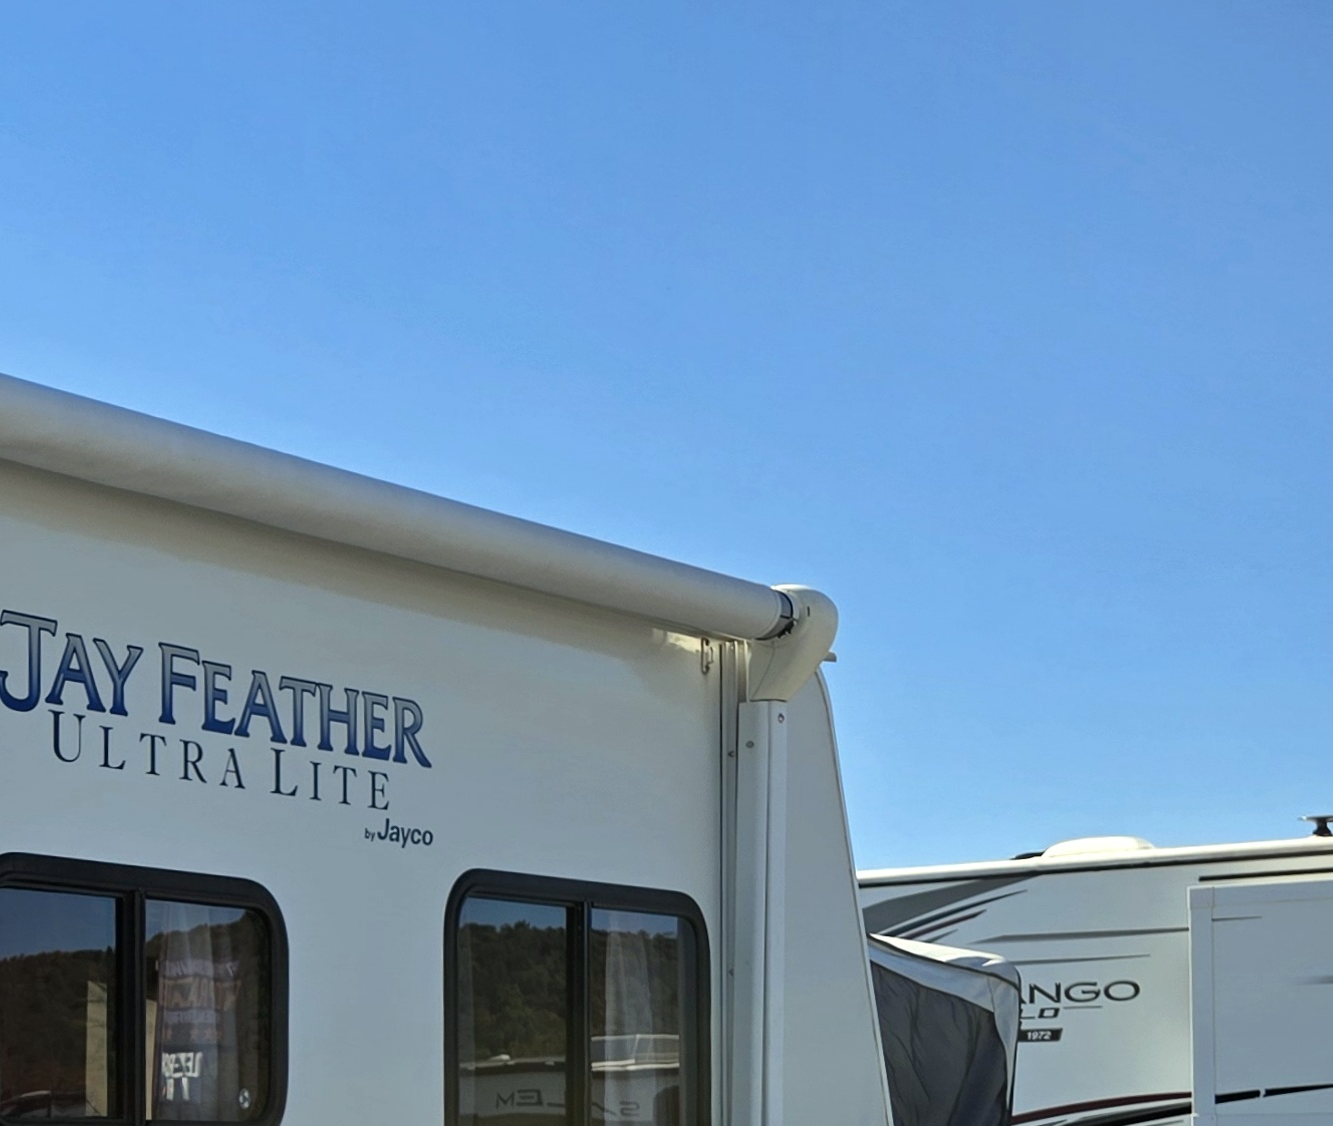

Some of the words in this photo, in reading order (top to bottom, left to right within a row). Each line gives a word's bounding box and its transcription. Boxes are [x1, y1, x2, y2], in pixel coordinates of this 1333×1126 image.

[158, 642, 432, 768] FEATHER
[48, 709, 246, 789] ULTRA
[270, 748, 390, 810] LITE
[364, 827, 375, 841] by
[377, 818, 434, 848] Jayco
[1027, 1031, 1052, 1040] 1972
